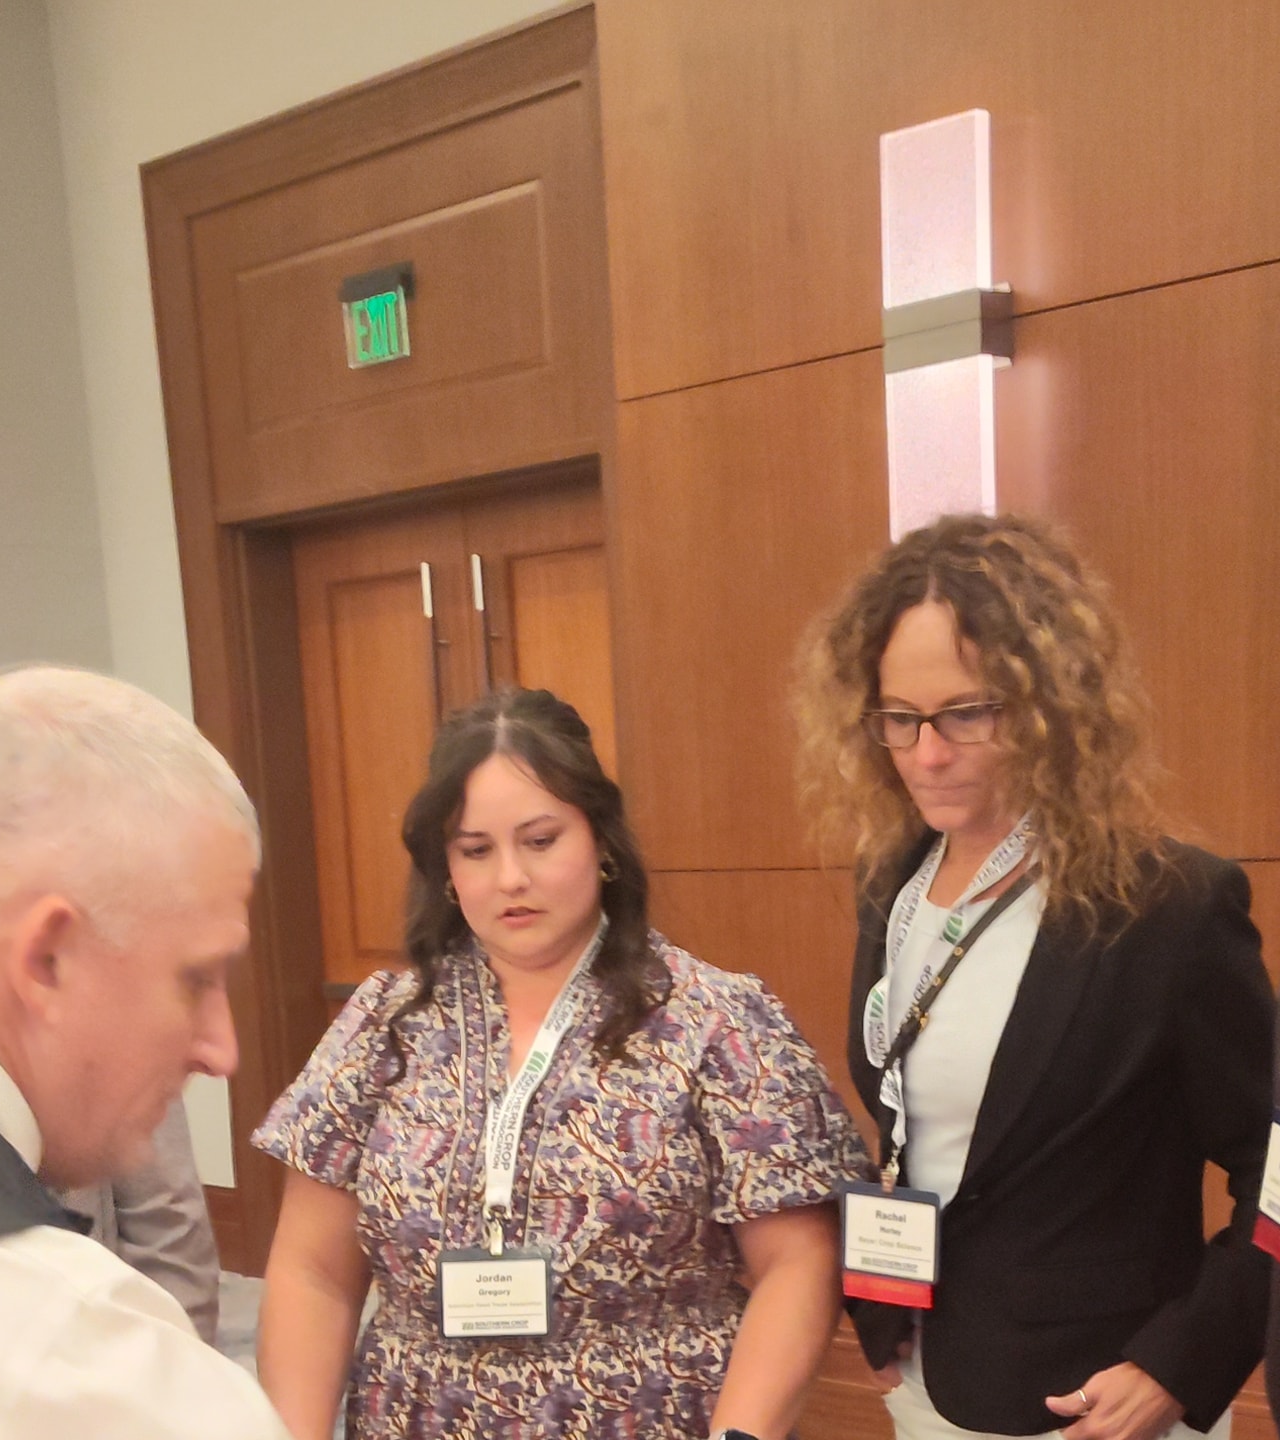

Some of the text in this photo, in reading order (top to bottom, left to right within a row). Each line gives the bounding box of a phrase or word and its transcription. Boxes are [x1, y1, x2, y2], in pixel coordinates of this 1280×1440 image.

[352, 291, 398, 362] EXIT
[913, 964, 933, 1002] CROP
[503, 1131, 516, 1171] CROP
[875, 1210, 907, 1223] Rachel
[476, 1274, 513, 1283] Jordan
[478, 1288, 511, 1296] Gregory
